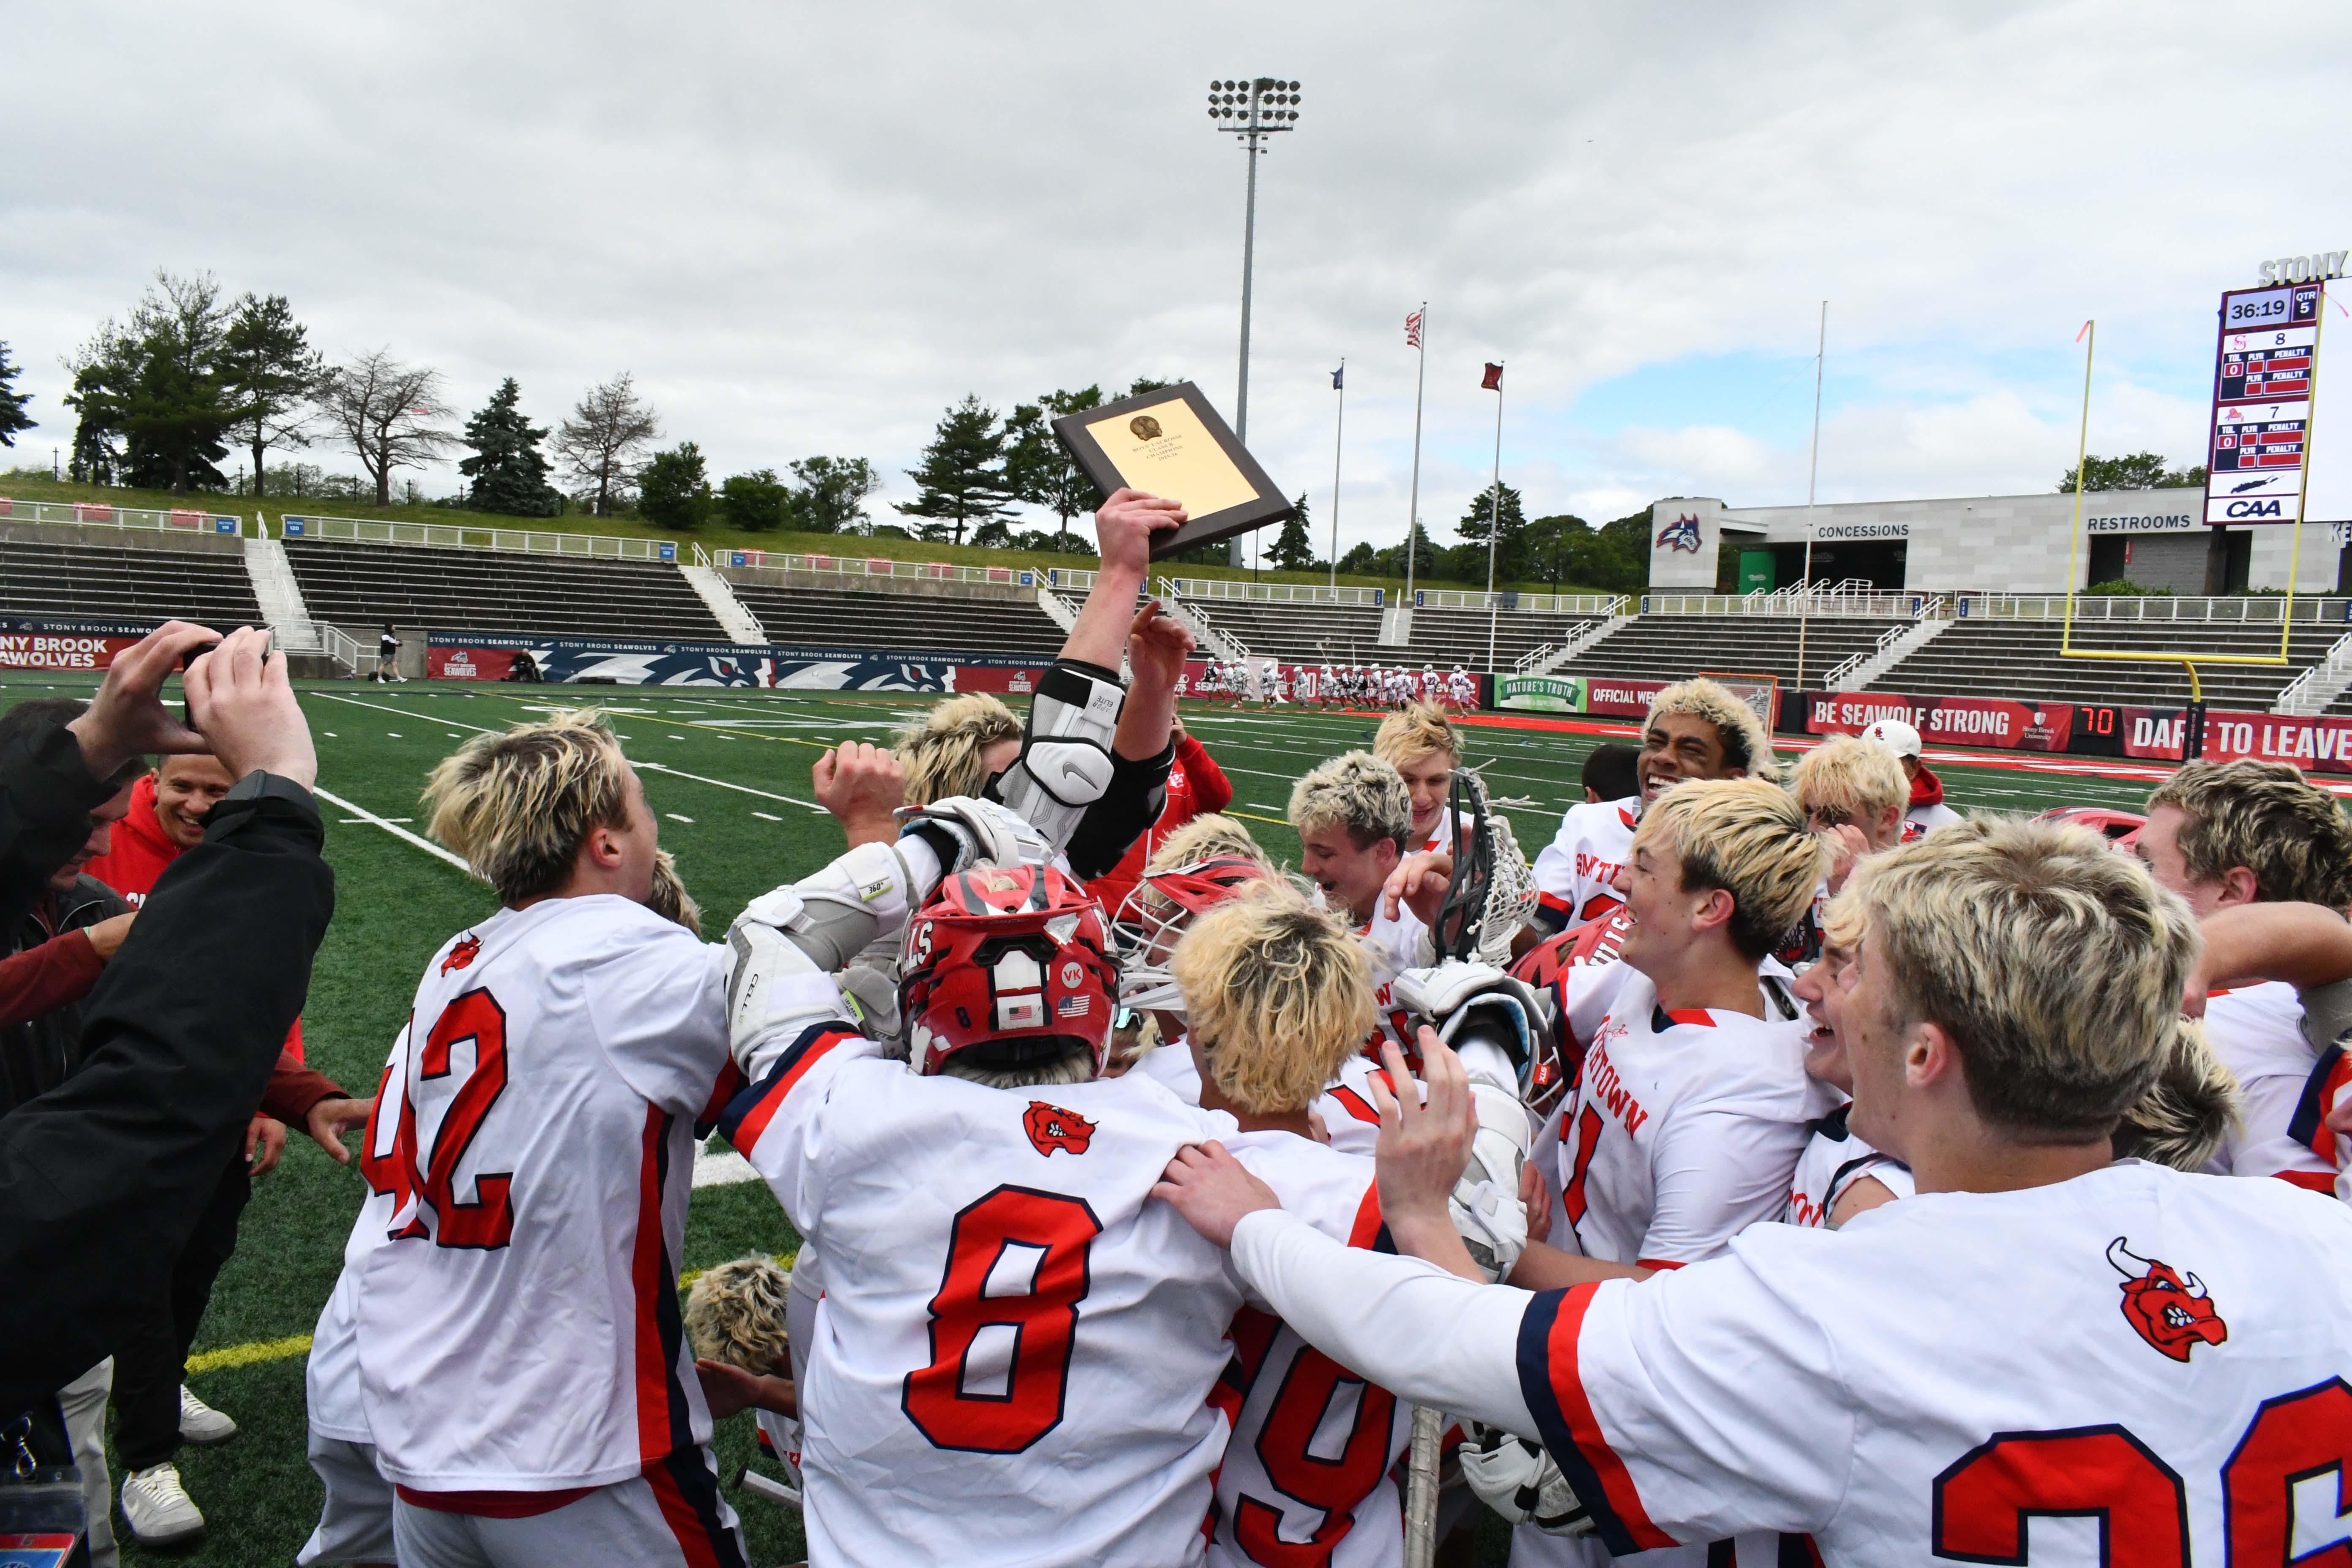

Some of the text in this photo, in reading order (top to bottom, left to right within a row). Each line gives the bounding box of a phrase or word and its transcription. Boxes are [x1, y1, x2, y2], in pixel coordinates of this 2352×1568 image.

[2258, 250, 2349, 288] STONY
[2296, 291, 2316, 301] QTR
[2231, 300, 2285, 319] 36:19
[2300, 302, 2309, 313] 5
[2276, 333, 2285, 345] 8
[2228, 348, 2306, 362] TOL PLYR PENALTY
[2230, 365, 2238, 375] 0
[2273, 371, 2304, 380] PENALTY
[2270, 406, 2279, 419] 7
[2222, 426, 2235, 434] TOL
[2268, 422, 2299, 431] PENALTY
[2224, 437, 2232, 447] 0
[2266, 445, 2297, 453] PENALTY
[2227, 500, 2281, 517] CAA
[2088, 515, 2190, 530] RESTROOMS
[1818, 525, 1908, 537] CONCESSIONS
[34, 638, 107, 653] BROOK
[444, 667, 476, 676] SEAWOLVES
[1428, 677, 1435, 685] 22
[1507, 681, 1573, 698] NATURE'S TRUTH
[1593, 689, 1635, 703] OFFICIAL
[1097, 696, 1113, 708] ELITE
[1815, 702, 2009, 735] BE SEAWOLF STRONG
[2081, 708, 2113, 734] 70
[2025, 732, 2051, 741] University
[2218, 722, 2253, 754] TO
[2262, 724, 2352, 760] LEAVE
[868, 882, 884, 894] 360+
[1063, 969, 1081, 981] VK
[741, 973, 758, 1011] CELL
[956, 1006, 971, 1027] 8
[1538, 1066, 1547, 1083] STX
[901, 1183, 1104, 1454] 8
